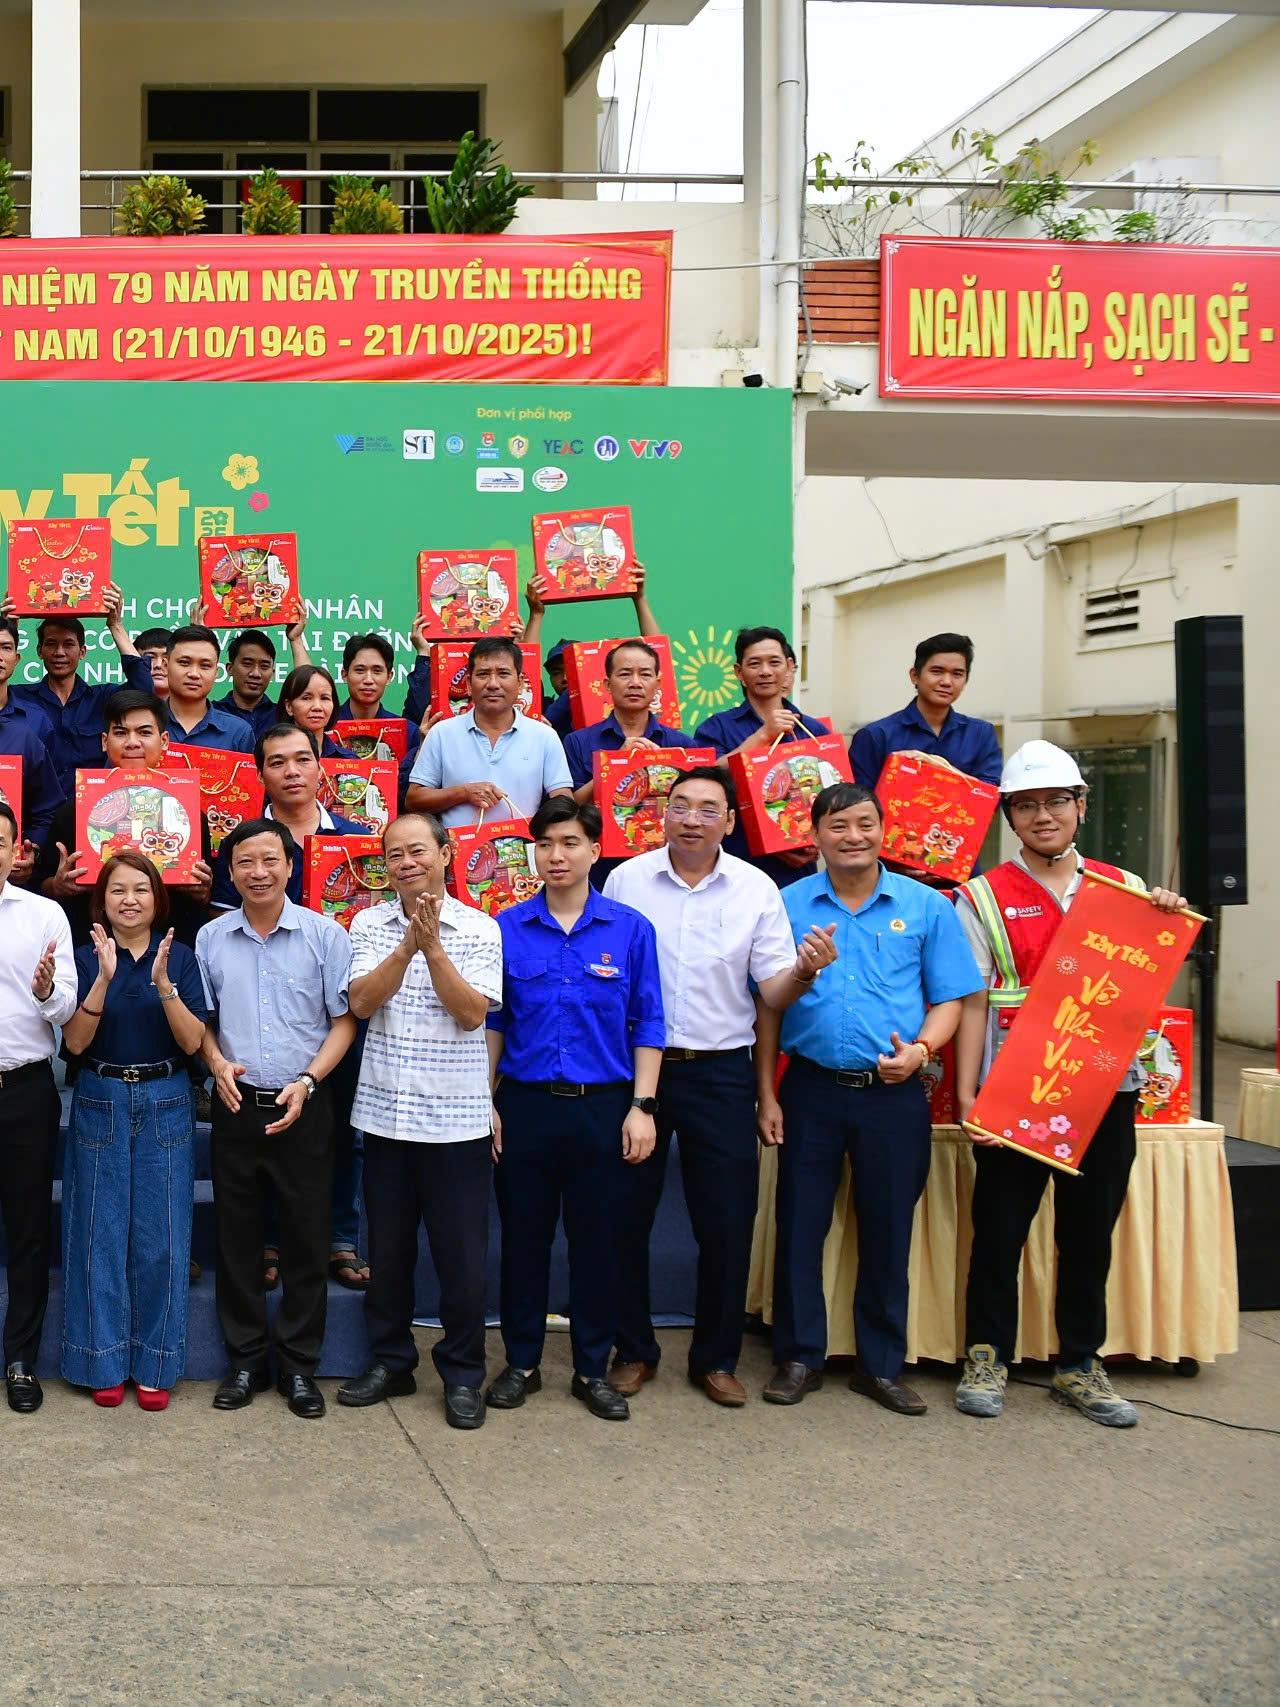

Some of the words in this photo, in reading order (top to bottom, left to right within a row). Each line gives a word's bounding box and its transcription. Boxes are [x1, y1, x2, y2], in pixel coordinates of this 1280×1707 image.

[3, 266, 95, 312] NIỆM
[108, 271, 152, 304] 79
[164, 264, 249, 303] NĂM
[261, 262, 359, 302] NGÀY
[371, 257, 510, 301] TRUYỀN
[522, 256, 642, 300] THỐNG
[909, 275, 1007, 358] NGĂN
[1017, 265, 1093, 369] NẮP,
[1103, 291, 1196, 376] SẠCH
[13, 328, 98, 361] NAM
[112, 325, 327, 363] (21/10/1946
[364, 322, 592, 359] 21/10/2025)!
[476, 407, 501, 419] Đơn
[505, 408, 516, 421] vị
[519, 406, 545, 421] phối
[547, 408, 572, 422] hợp
[543, 439, 584, 455] YEAC
[628, 439, 683, 459] VTV9
[63, 457, 190, 546] Tết
[305, 594, 383, 620] NHÂN
[1081, 930, 1121, 961] Xây
[1119, 944, 1149, 970] Tết
[1052, 995, 1105, 1044] Nhà
[1044, 1036, 1084, 1075] Vui
[1031, 1070, 1072, 1105] Vẻ
